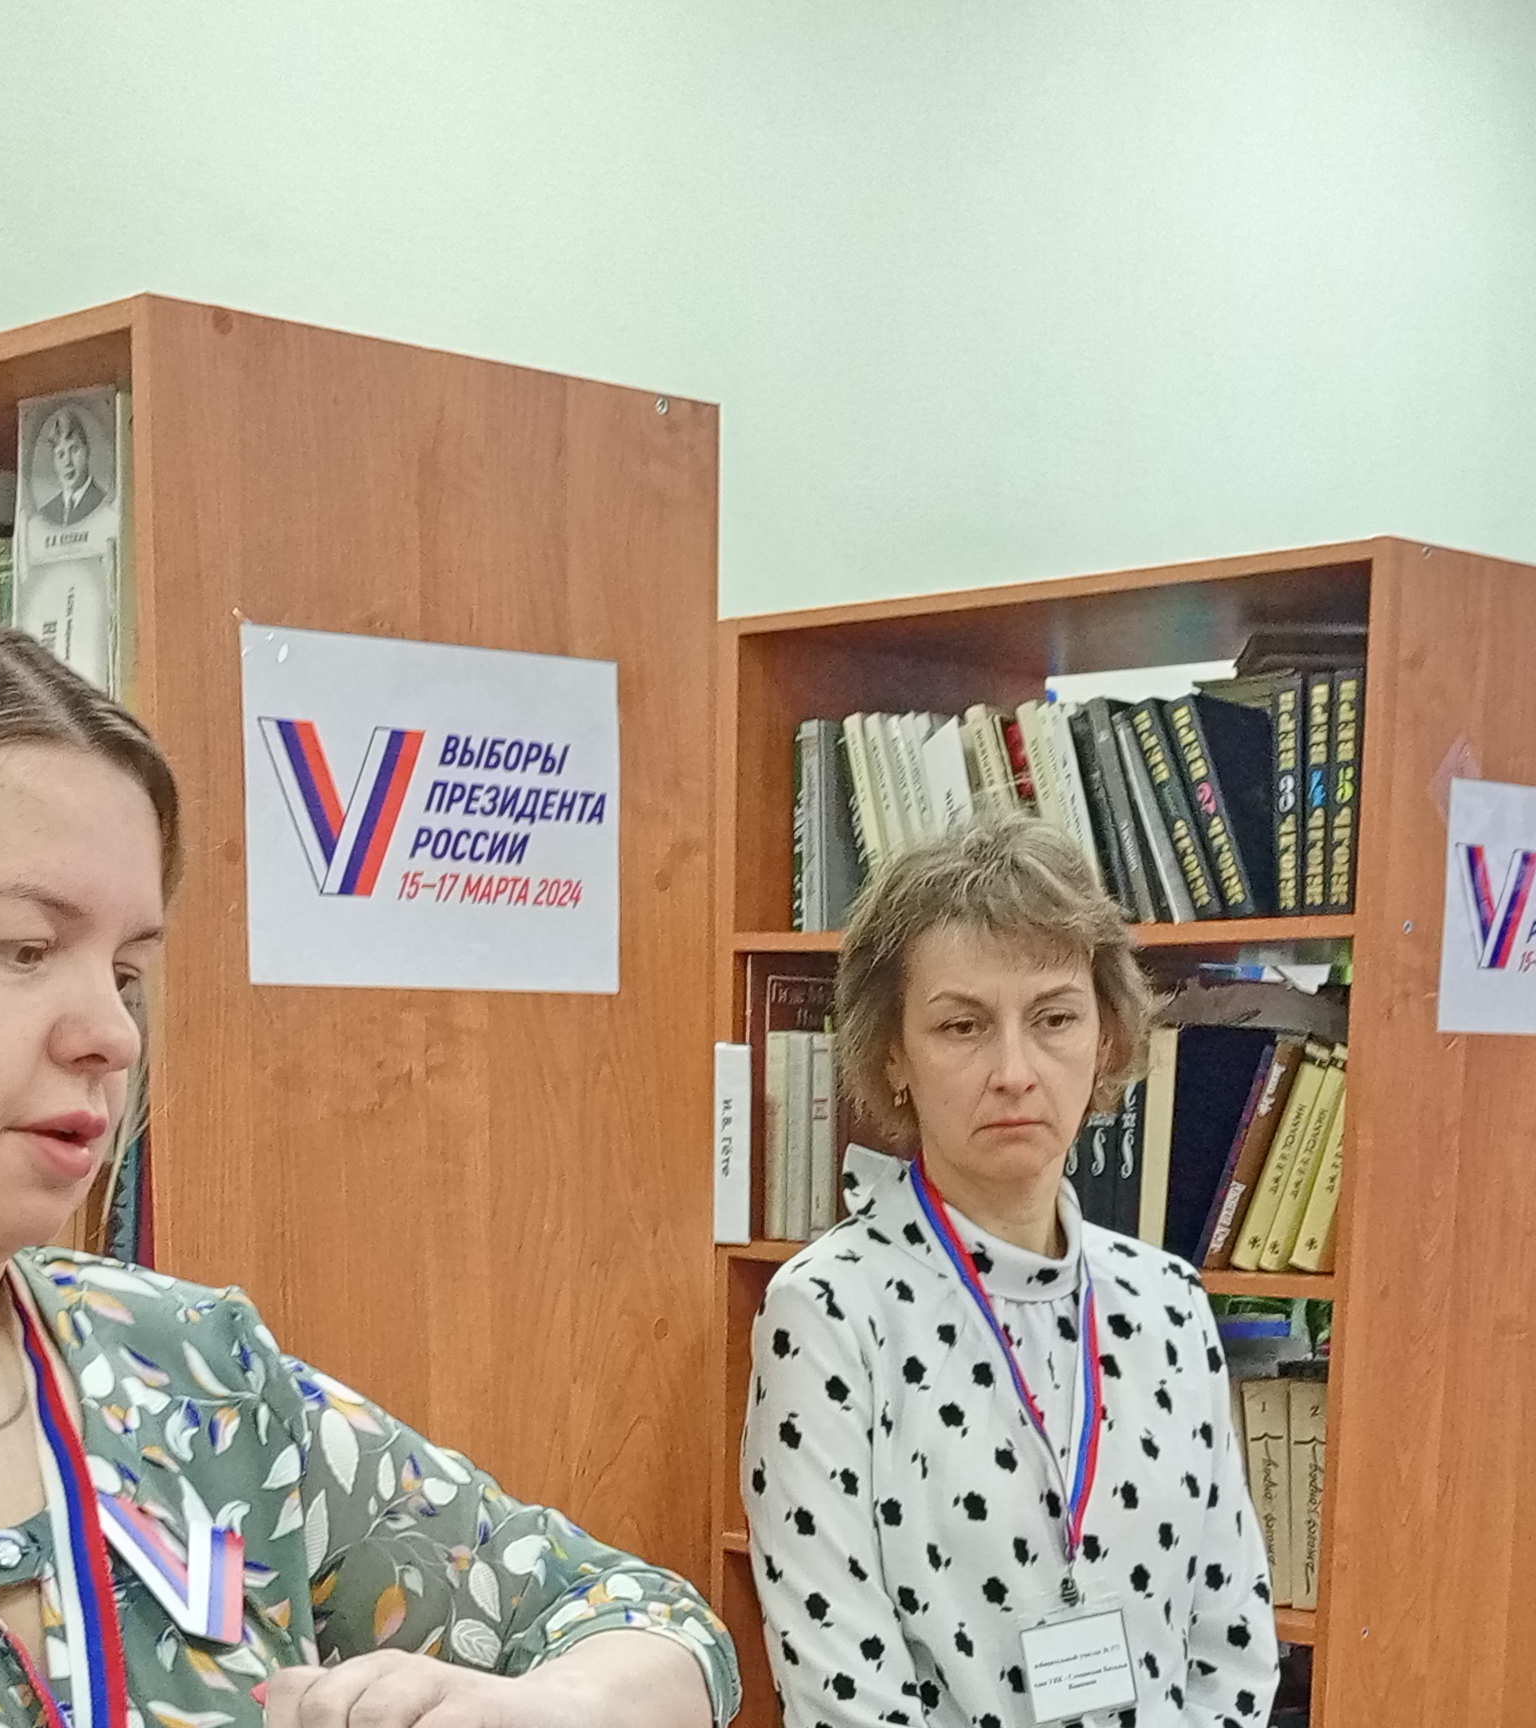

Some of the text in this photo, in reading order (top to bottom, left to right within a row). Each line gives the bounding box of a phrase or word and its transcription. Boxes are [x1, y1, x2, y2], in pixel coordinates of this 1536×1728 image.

[438, 733, 571, 775] ВЫБОРЫ
[423, 780, 607, 826] ПРЕЗИДЕНТА
[1196, 782, 1217, 815] 2
[1278, 774, 1295, 812] 3
[1308, 770, 1326, 807] 4
[1336, 766, 1354, 804] 5
[409, 827, 531, 865] РОССИИ
[460, 874, 530, 906] МАРТА
[531, 877, 583, 909] 2024
